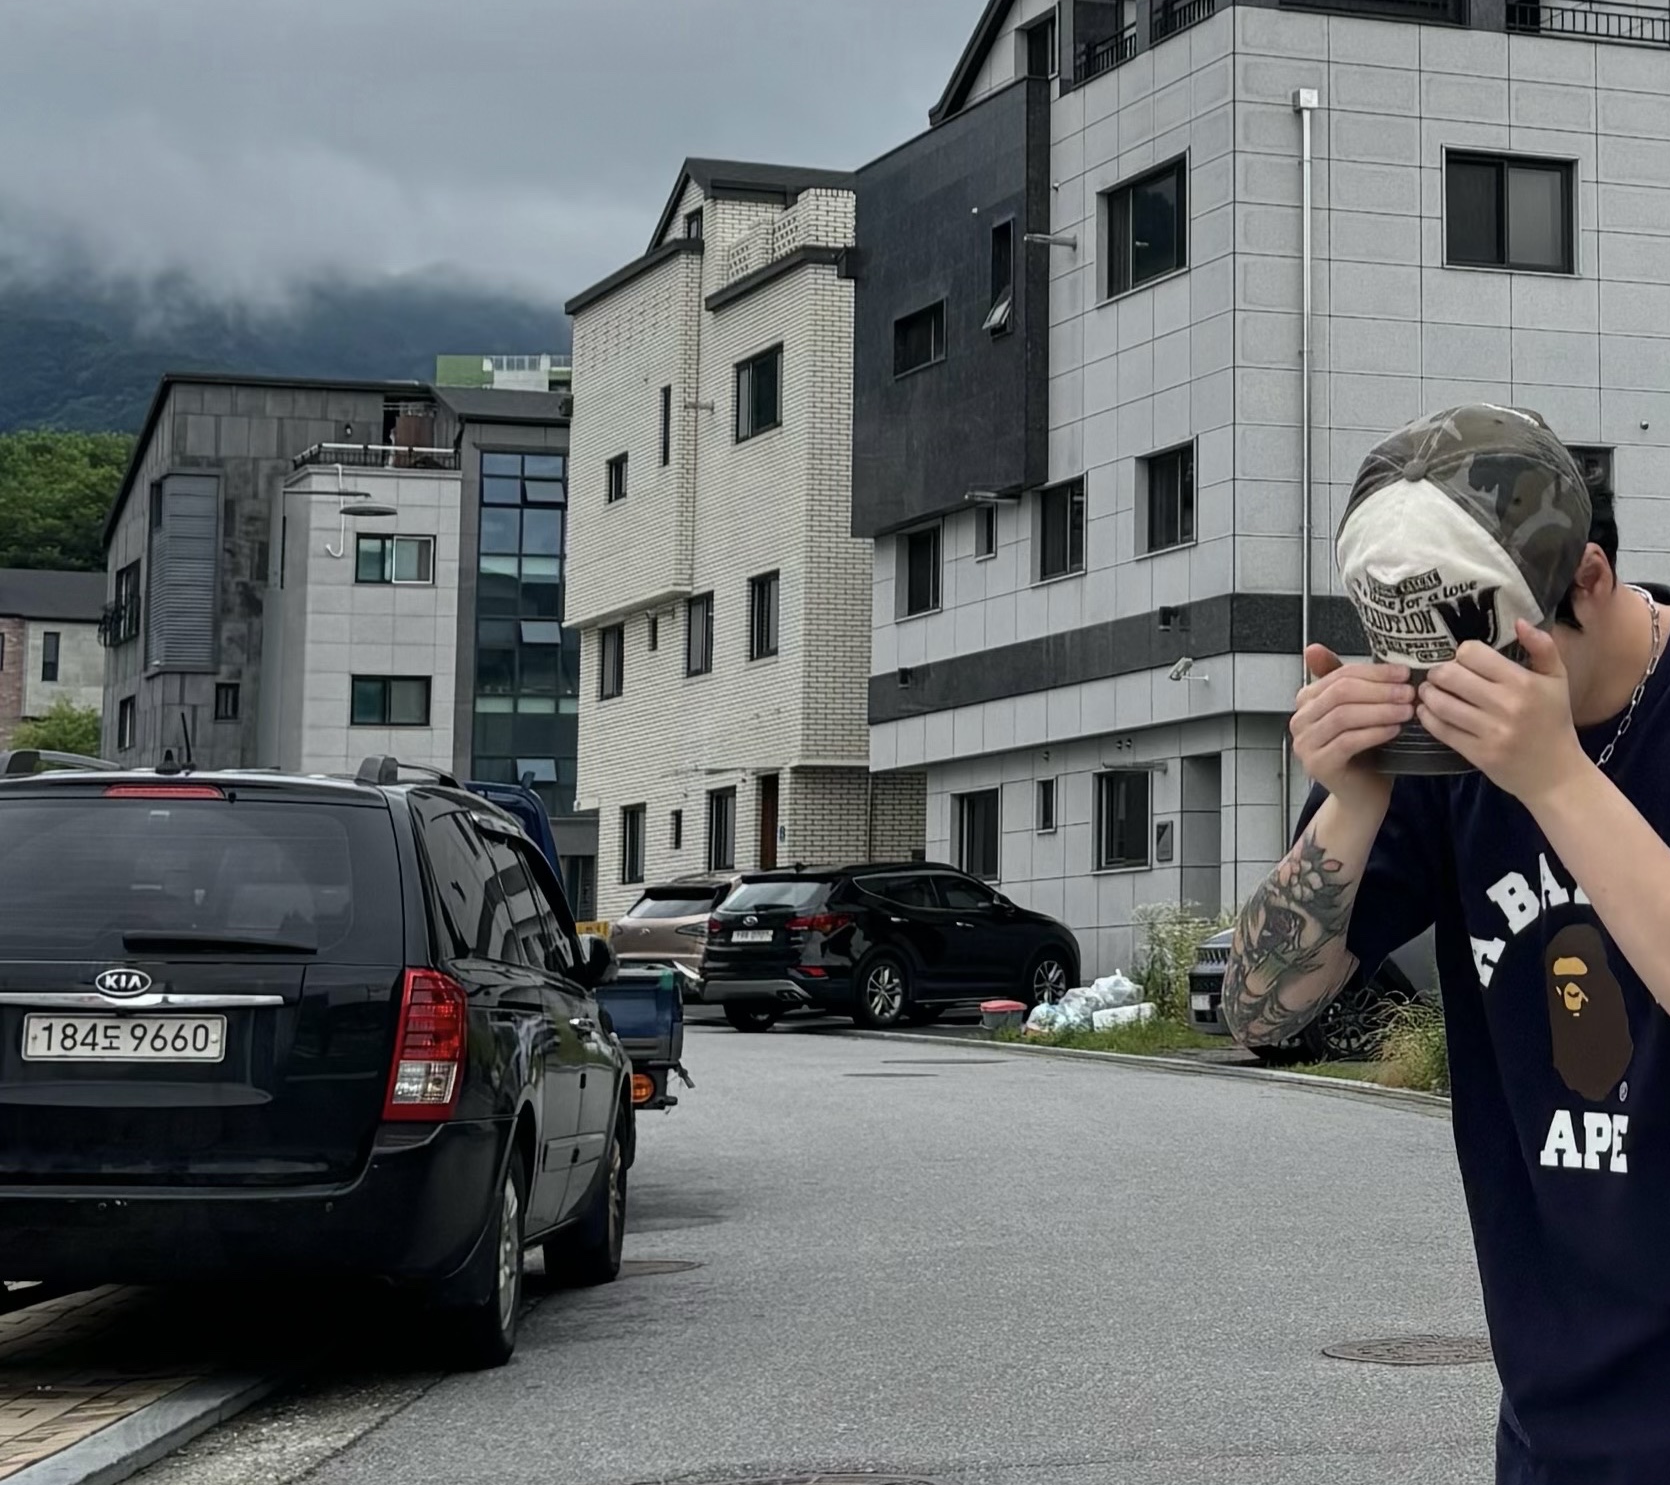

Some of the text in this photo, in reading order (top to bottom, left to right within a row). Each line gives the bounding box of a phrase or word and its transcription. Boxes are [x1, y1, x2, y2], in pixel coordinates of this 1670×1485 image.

[1398, 593, 1422, 614] for
[1427, 591, 1440, 603] a
[1442, 579, 1478, 600] love
[104, 974, 142, 990] KIA
[129, 1022, 210, 1053] 9660
[1539, 1108, 1630, 1174] APE
